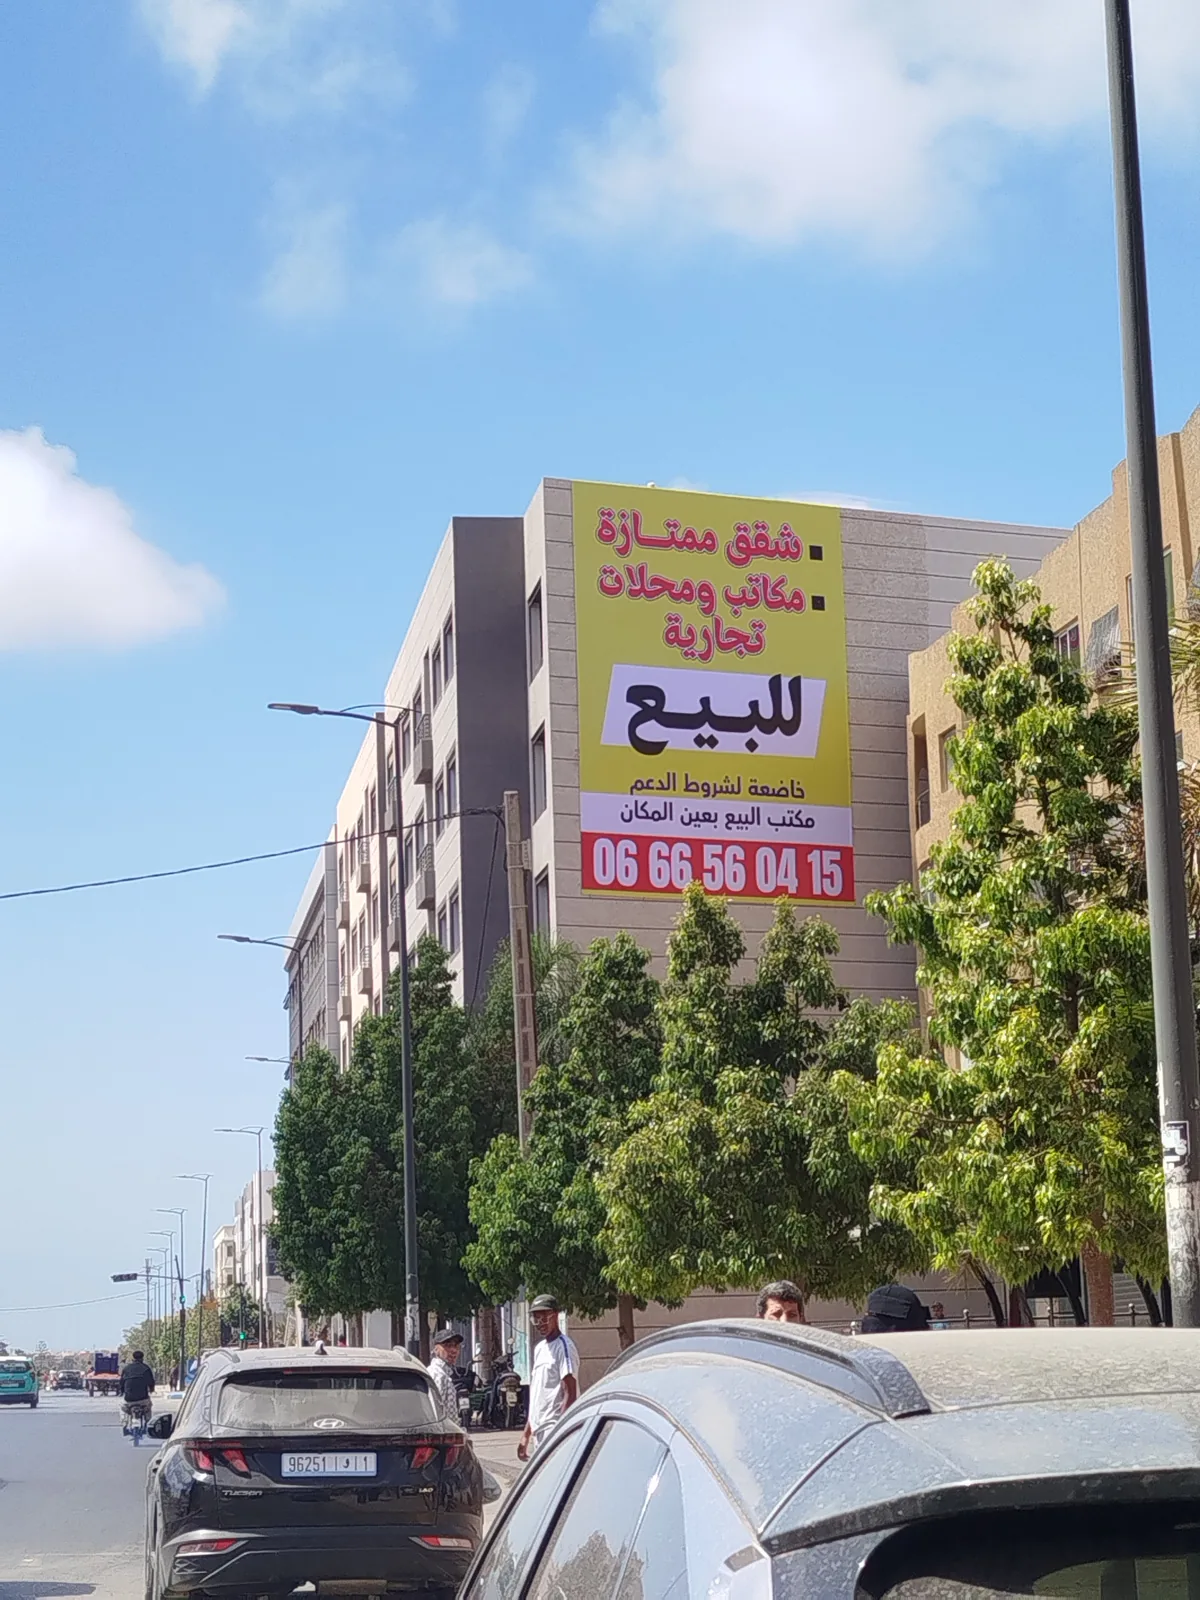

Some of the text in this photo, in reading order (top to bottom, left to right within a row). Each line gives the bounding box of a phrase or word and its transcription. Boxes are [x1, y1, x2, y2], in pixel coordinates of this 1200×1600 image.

[596, 507, 804, 567] شقق ممتازة
[598, 563, 806, 618] مكاتب ومحلات
[663, 612, 766, 663] تجارية
[626, 674, 801, 755] للبيع
[629, 772, 805, 799] خاضعة لشروط الدعم
[620, 800, 815, 832] مكتب البيع بعين المكان
[593, 838, 843, 896] 06 66 56 04 15
[288, 1456, 326, 1472] 96251
